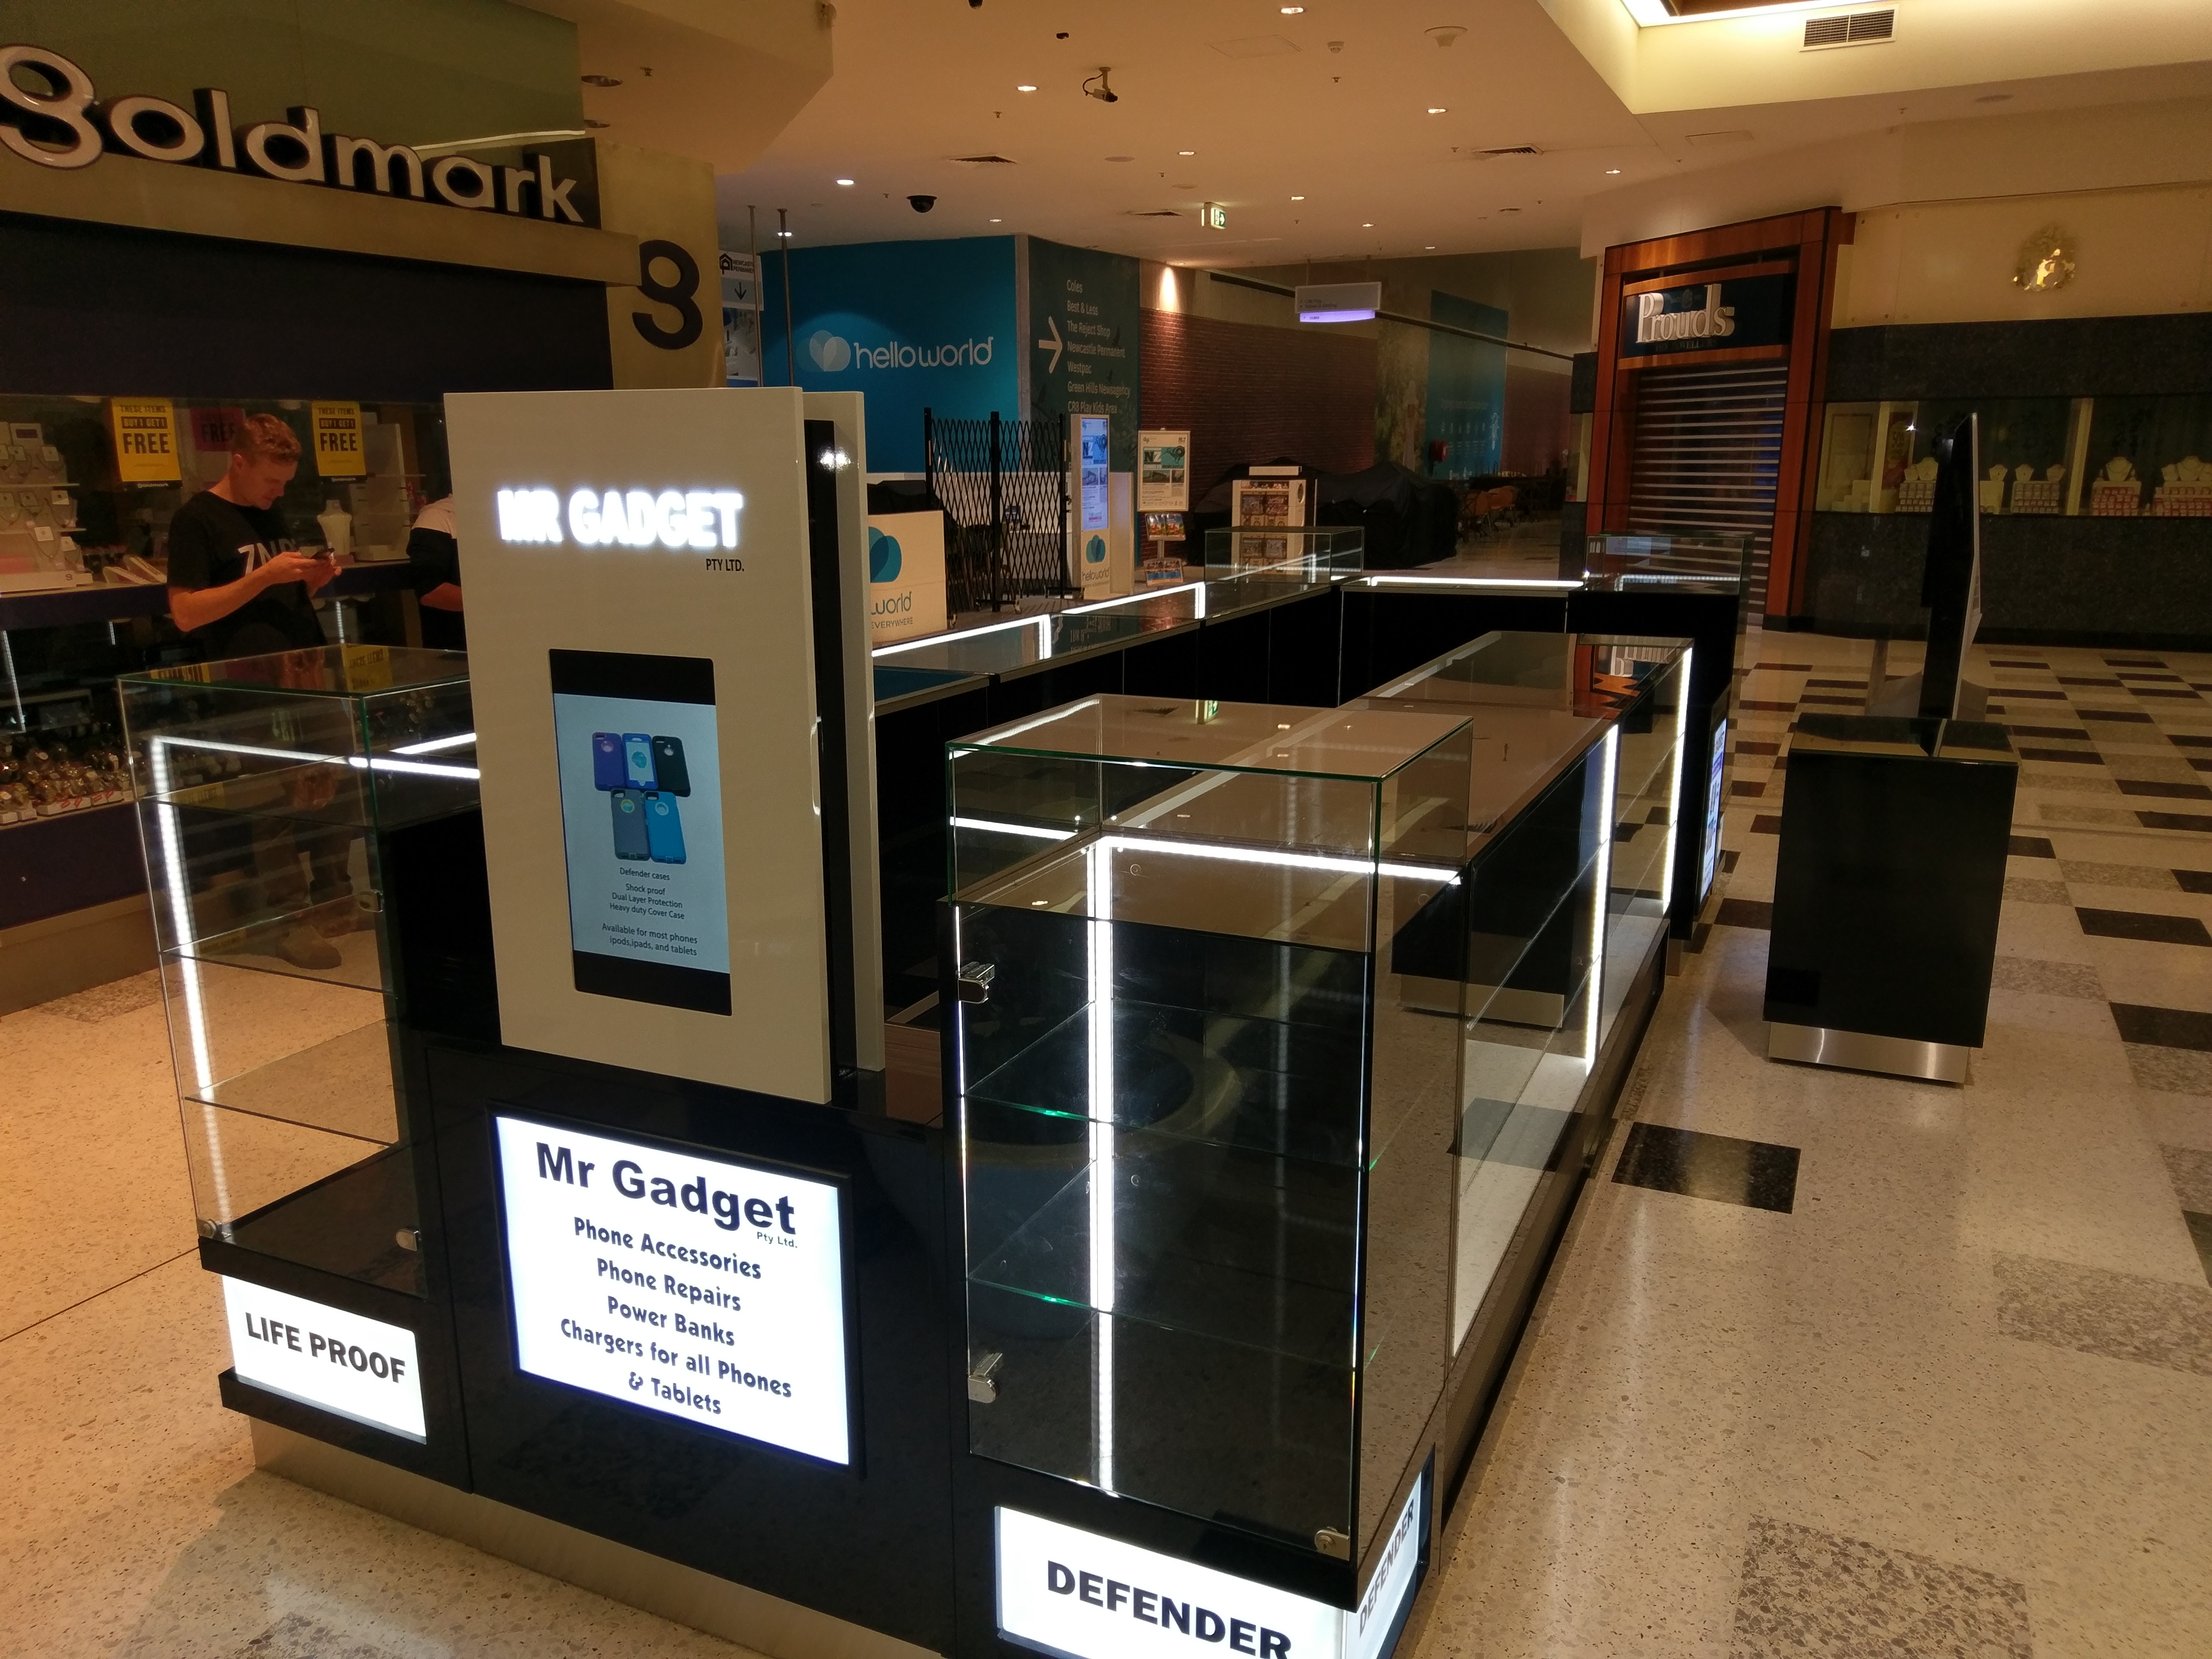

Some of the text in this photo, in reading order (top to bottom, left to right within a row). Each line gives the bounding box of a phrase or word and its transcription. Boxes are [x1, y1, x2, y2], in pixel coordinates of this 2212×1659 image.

[1067, 280, 1083, 293] Coles
[1067, 300, 1098, 315] Best & Less
[1636, 284, 1735, 344] Prouds
[1067, 320, 1110, 340] The Reject Shop
[854, 337, 993, 369] helloworld
[1067, 341, 1125, 357] Newcastle Permanent
[1067, 361, 1092, 376] Westpac
[1068, 381, 1130, 398] Green Hills Newsagency
[1081, 401, 1092, 414] Play
[1093, 401, 1104, 413] Kids
[1106, 404, 1117, 414] Area
[124, 418, 139, 427] BUY
[147, 418, 160, 427] GET
[123, 432, 170, 454] FREE
[320, 432, 358, 452] FREE
[1144, 450, 1161, 462] NZ
[568, 490, 744, 547] GADGET
[706, 559, 744, 572] PTY LTD.
[872, 617, 913, 629] EVERYWHERE
[620, 868, 650, 878] Defender
[625, 884, 666, 895] Shock proof
[612, 892, 683, 908] Dual Layer Protection
[610, 902, 685, 919] Heavy duty Cover Case
[602, 923, 698, 944] Available for most phones
[655, 943, 669, 952] and
[671, 946, 697, 956] tablets
[536, 1141, 796, 1235] Mr Gadget
[574, 1217, 761, 1280] Phone Accessories
[757, 1232, 798, 1248] Pty Ltd.
[597, 1258, 742, 1312] Phone Repairs
[608, 1296, 735, 1346] Power Banks
[246, 1312, 405, 1384] LIFE PROOF
[561, 1318, 792, 1398] Chargers for all Phones
[629, 1371, 721, 1415] & Tablets
[1359, 1498, 1415, 1639] DEFENDER
[1047, 1559, 1292, 1659] DEFENDER
